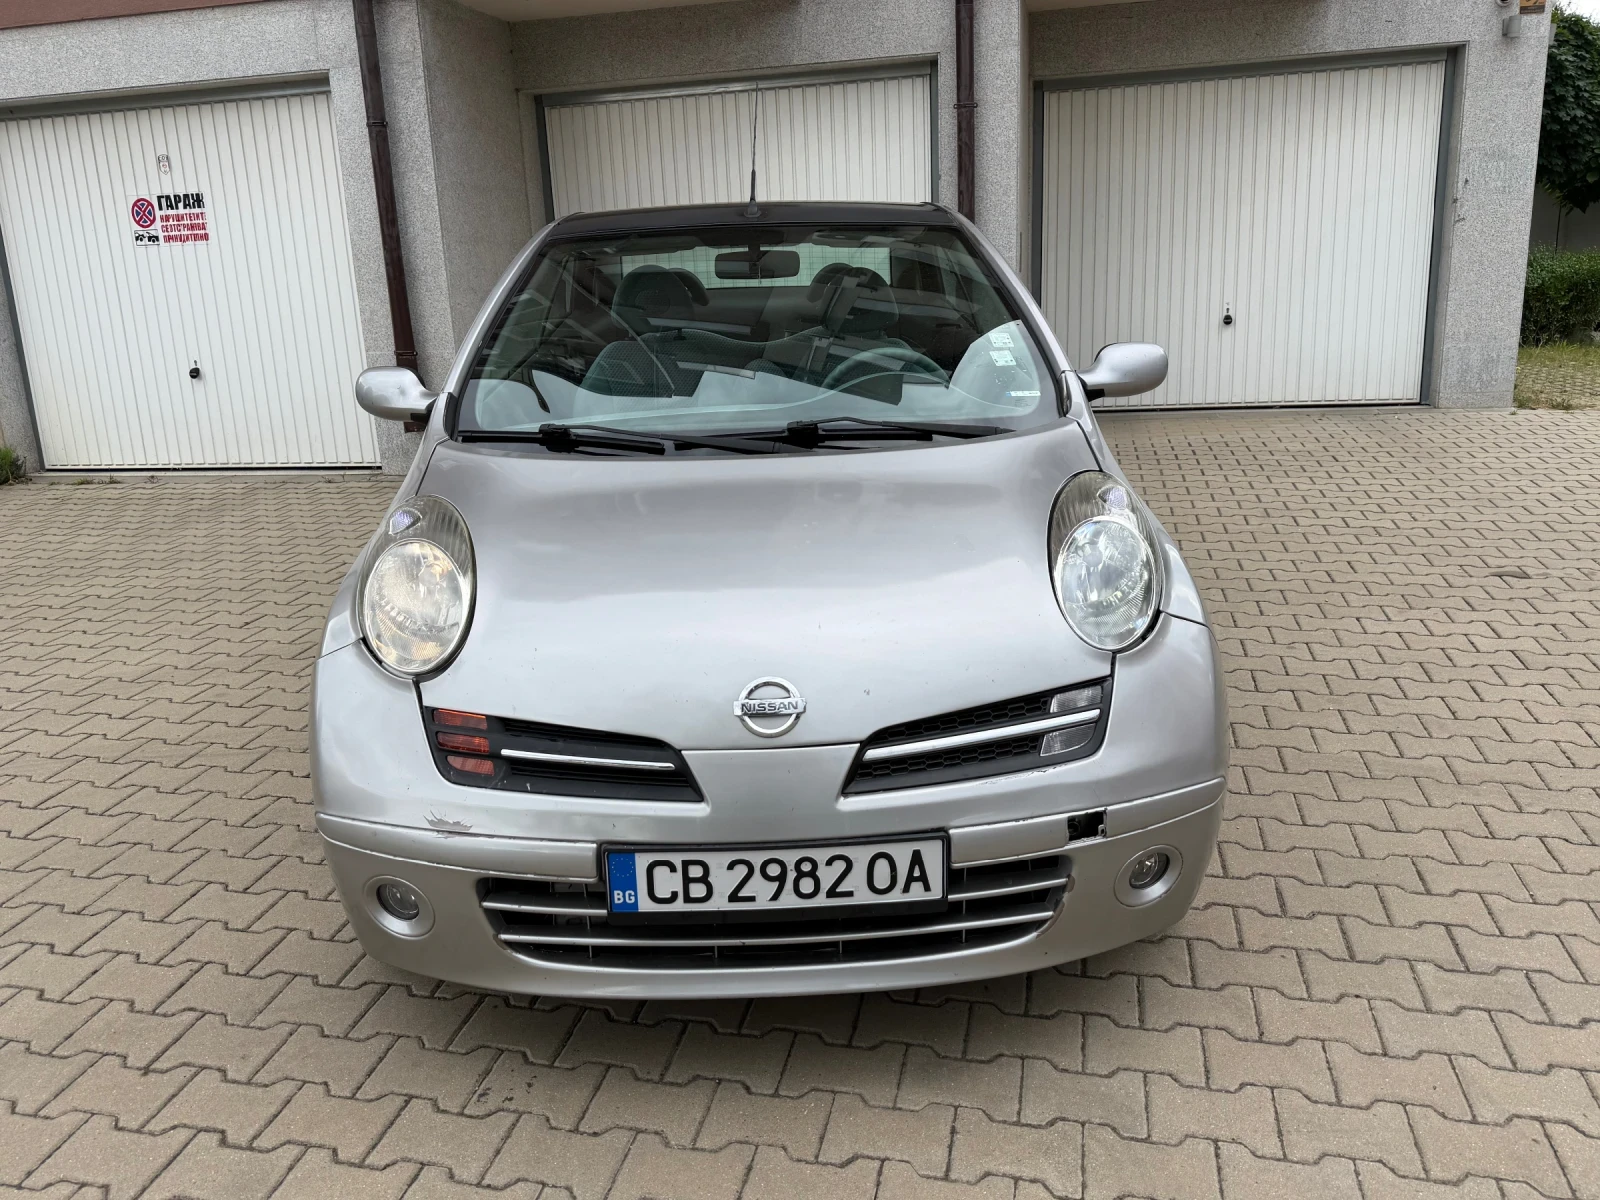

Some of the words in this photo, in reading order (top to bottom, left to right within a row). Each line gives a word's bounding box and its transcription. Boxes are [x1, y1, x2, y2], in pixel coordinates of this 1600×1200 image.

[156, 192, 205, 211] ГАРАЖ
[741, 701, 799, 713] NISSAN
[645, 859, 714, 904] CB
[726, 853, 855, 903] 2982
[613, 890, 636, 905] BG
